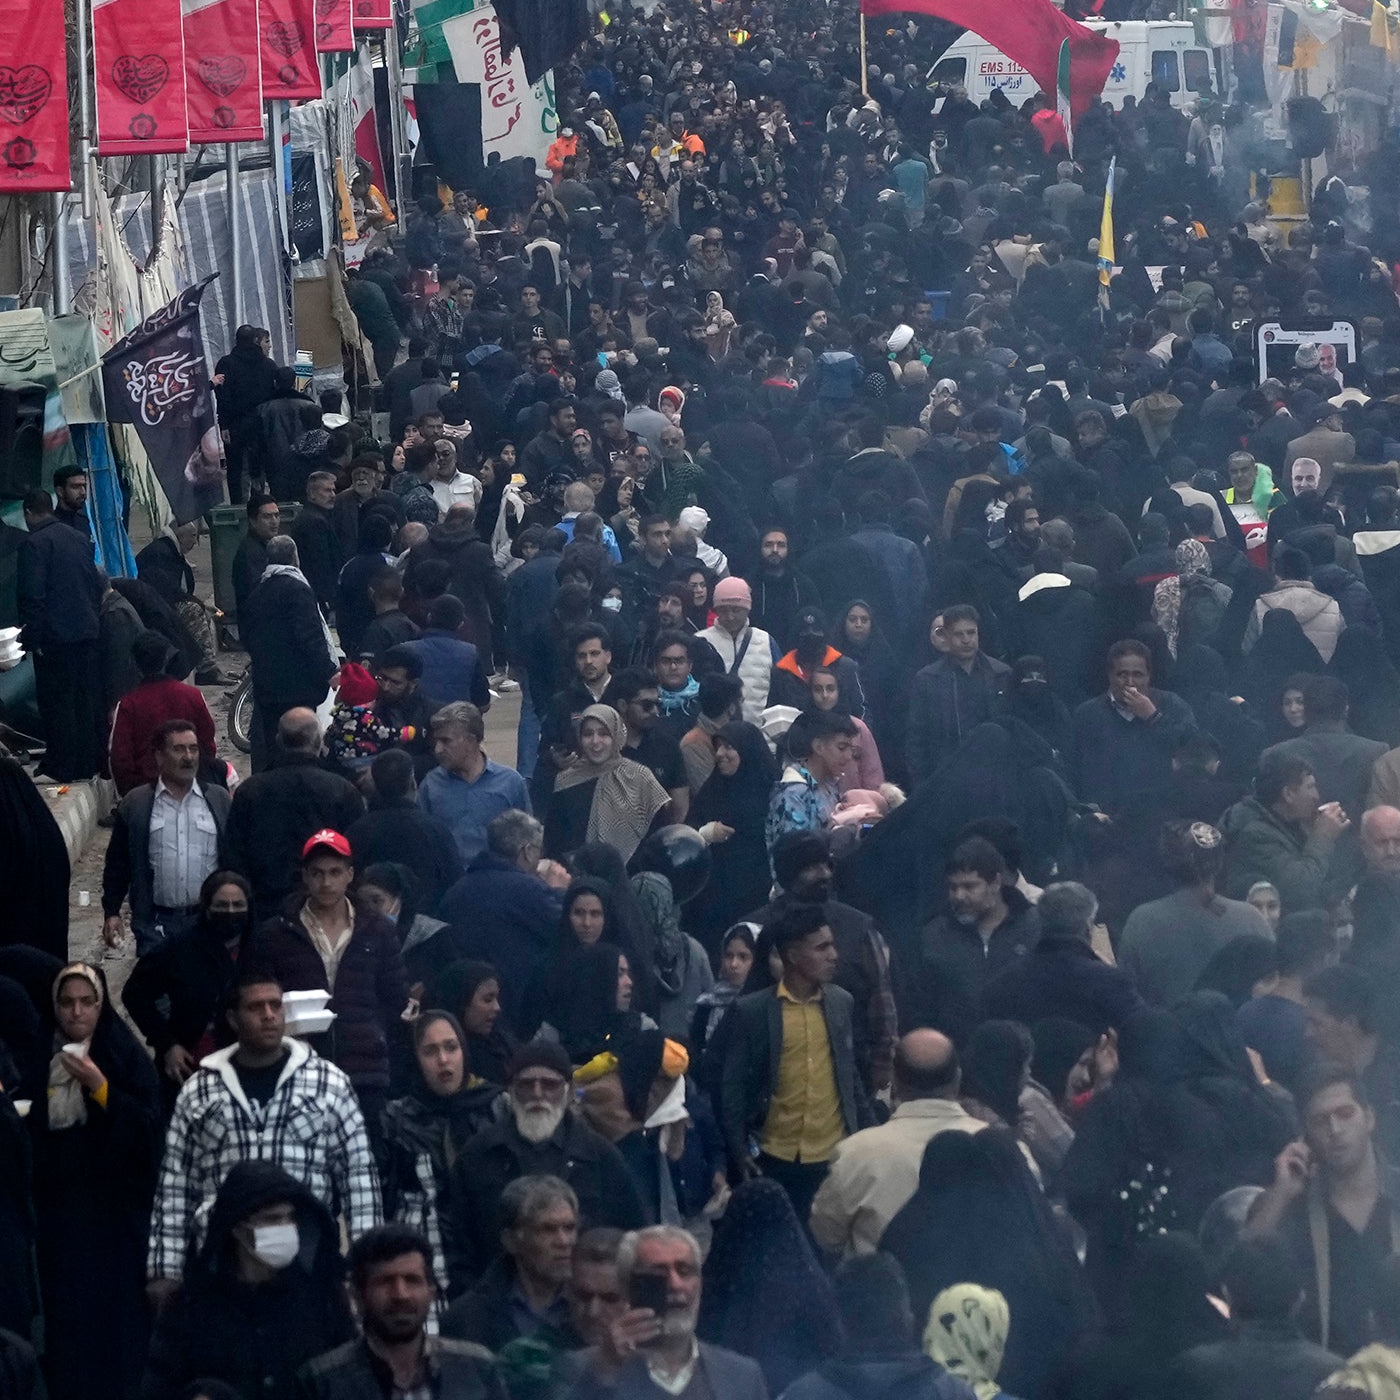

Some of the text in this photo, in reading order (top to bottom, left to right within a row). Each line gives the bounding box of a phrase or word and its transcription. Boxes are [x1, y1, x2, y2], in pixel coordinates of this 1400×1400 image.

[980, 62, 1003, 73] EMS
[984, 76, 1023, 89] اورژانس ۱۱۵
